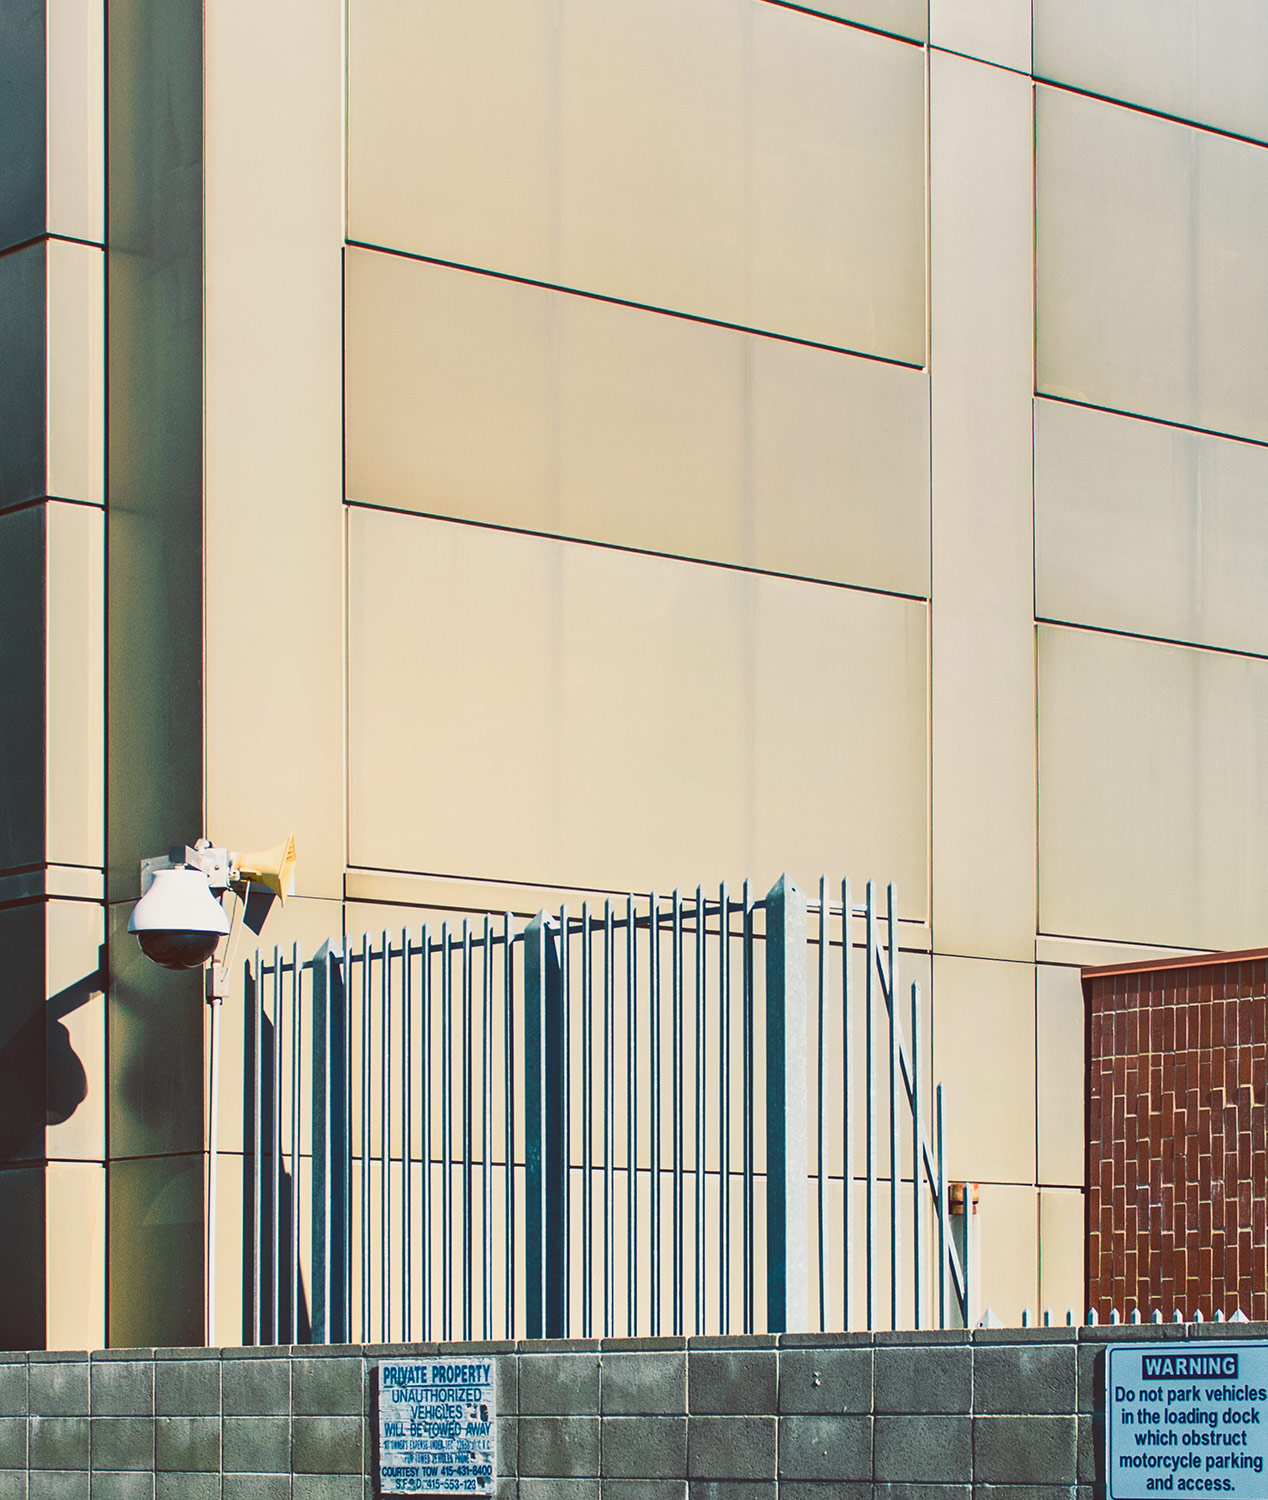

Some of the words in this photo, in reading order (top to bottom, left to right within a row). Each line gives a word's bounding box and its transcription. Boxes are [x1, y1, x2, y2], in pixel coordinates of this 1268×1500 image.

[383, 1365, 427, 1385] PRIVATE
[431, 1364, 490, 1383] PROPERTY
[1145, 1357, 1236, 1376] WARNING
[391, 1387, 482, 1403] UNAUTHORIZED
[1115, 1386, 1135, 1402] Do
[1139, 1387, 1163, 1401] not
[1167, 1385, 1201, 1405] park
[1205, 1385, 1267, 1401] vehicles
[410, 1404, 463, 1420] VEHICLES
[1121, 1408, 1134, 1424] in
[1137, 1408, 1160, 1424] the
[1164, 1408, 1218, 1427] loading
[1222, 1407, 1260, 1424] dock
[384, 1422, 406, 1437] WILL
[410, 1422, 423, 1437] BE
[427, 1422, 461, 1437] TOWED
[465, 1421, 491, 1436] AWAY
[1134, 1430, 1178, 1446] which
[1182, 1429, 1247, 1446] obstruct
[381, 1466, 419, 1477] COURTESY
[421, 1466, 438, 1477] TOW
[440, 1465, 493, 1476] 415-431-8400
[1119, 1452, 1201, 1472] motorcycle
[1205, 1452, 1263, 1473] parking
[426, 1478, 487, 1489] 415-553-123
[1146, 1474, 1173, 1491] and
[1177, 1477, 1235, 1491] access.
